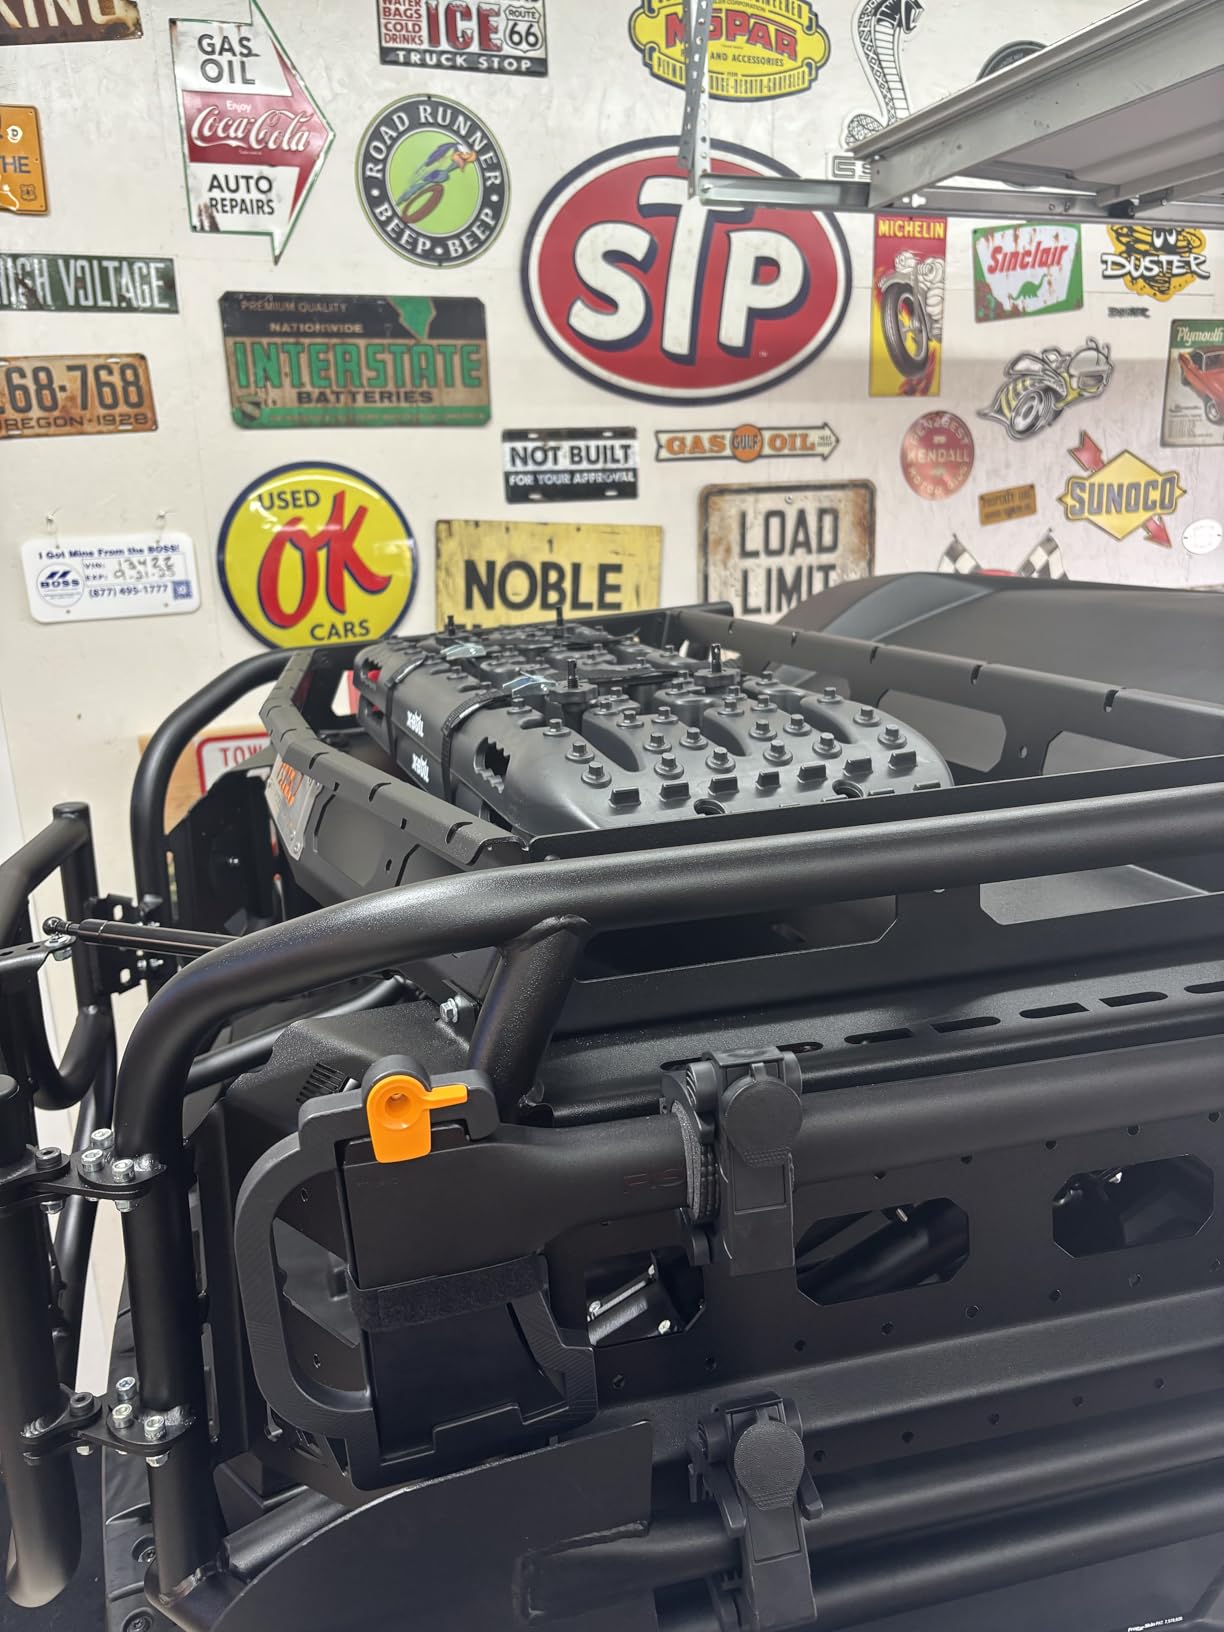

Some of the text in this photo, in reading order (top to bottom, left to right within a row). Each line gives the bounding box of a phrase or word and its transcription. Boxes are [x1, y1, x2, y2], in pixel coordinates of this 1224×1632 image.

[382, 6, 422, 19] BAGS
[508, 9, 536, 20] ROUTE
[383, 21, 422, 34] COLD
[426, 0, 504, 52] ICE
[508, 22, 539, 48] 66
[197, 33, 254, 58] GAS
[383, 33, 424, 46] DRINKS
[396, 51, 532, 72] TRUCK STOP
[710, 51, 784, 67] AND ACCESSORIES
[199, 58, 256, 85] OIL
[226, 100, 252, 114] Enjoy
[365, 104, 502, 187] ROAD RUNNER
[207, 173, 273, 195] AUTO
[208, 197, 275, 216] REPAIRS
[374, 202, 431, 254] BEEP
[446, 208, 498, 258] BEEP
[878, 219, 945, 240] MICHELIN
[986, 241, 1069, 275] Sinclair
[1100, 252, 1211, 279] DUSTER
[568, 176, 811, 366] STP
[57, 259, 170, 308] VOLTAGE
[240, 300, 348, 313] PREMIUM QUALITY
[269, 322, 364, 333] NATIONWIDE
[1176, 327, 1224, 346] Plymouth
[233, 341, 481, 388] INTERSTATE
[0, 363, 145, 413] 68-768
[296, 390, 434, 405] BATTERIES
[0, 416, 84, 431] REGON
[665, 433, 726, 455] GAS
[732, 434, 760, 450] GULF
[767, 432, 816, 452] OIL
[509, 444, 633, 467] NOT BUILT
[906, 447, 970, 463] KENDALL
[508, 471, 635, 487] FOR YOUR APPROVAL
[258, 489, 320, 511] USED
[1069, 475, 1178, 519] SUNOCO
[740, 507, 839, 559] LOAD
[46, 551, 66, 560] Got
[69, 549, 95, 558] Mine
[98, 548, 125, 557] From
[128, 546, 145, 555] the
[257, 490, 392, 629] OK
[40, 580, 80, 589] BOSS
[464, 559, 623, 611] NOBLE
[310, 619, 371, 641] CARS
